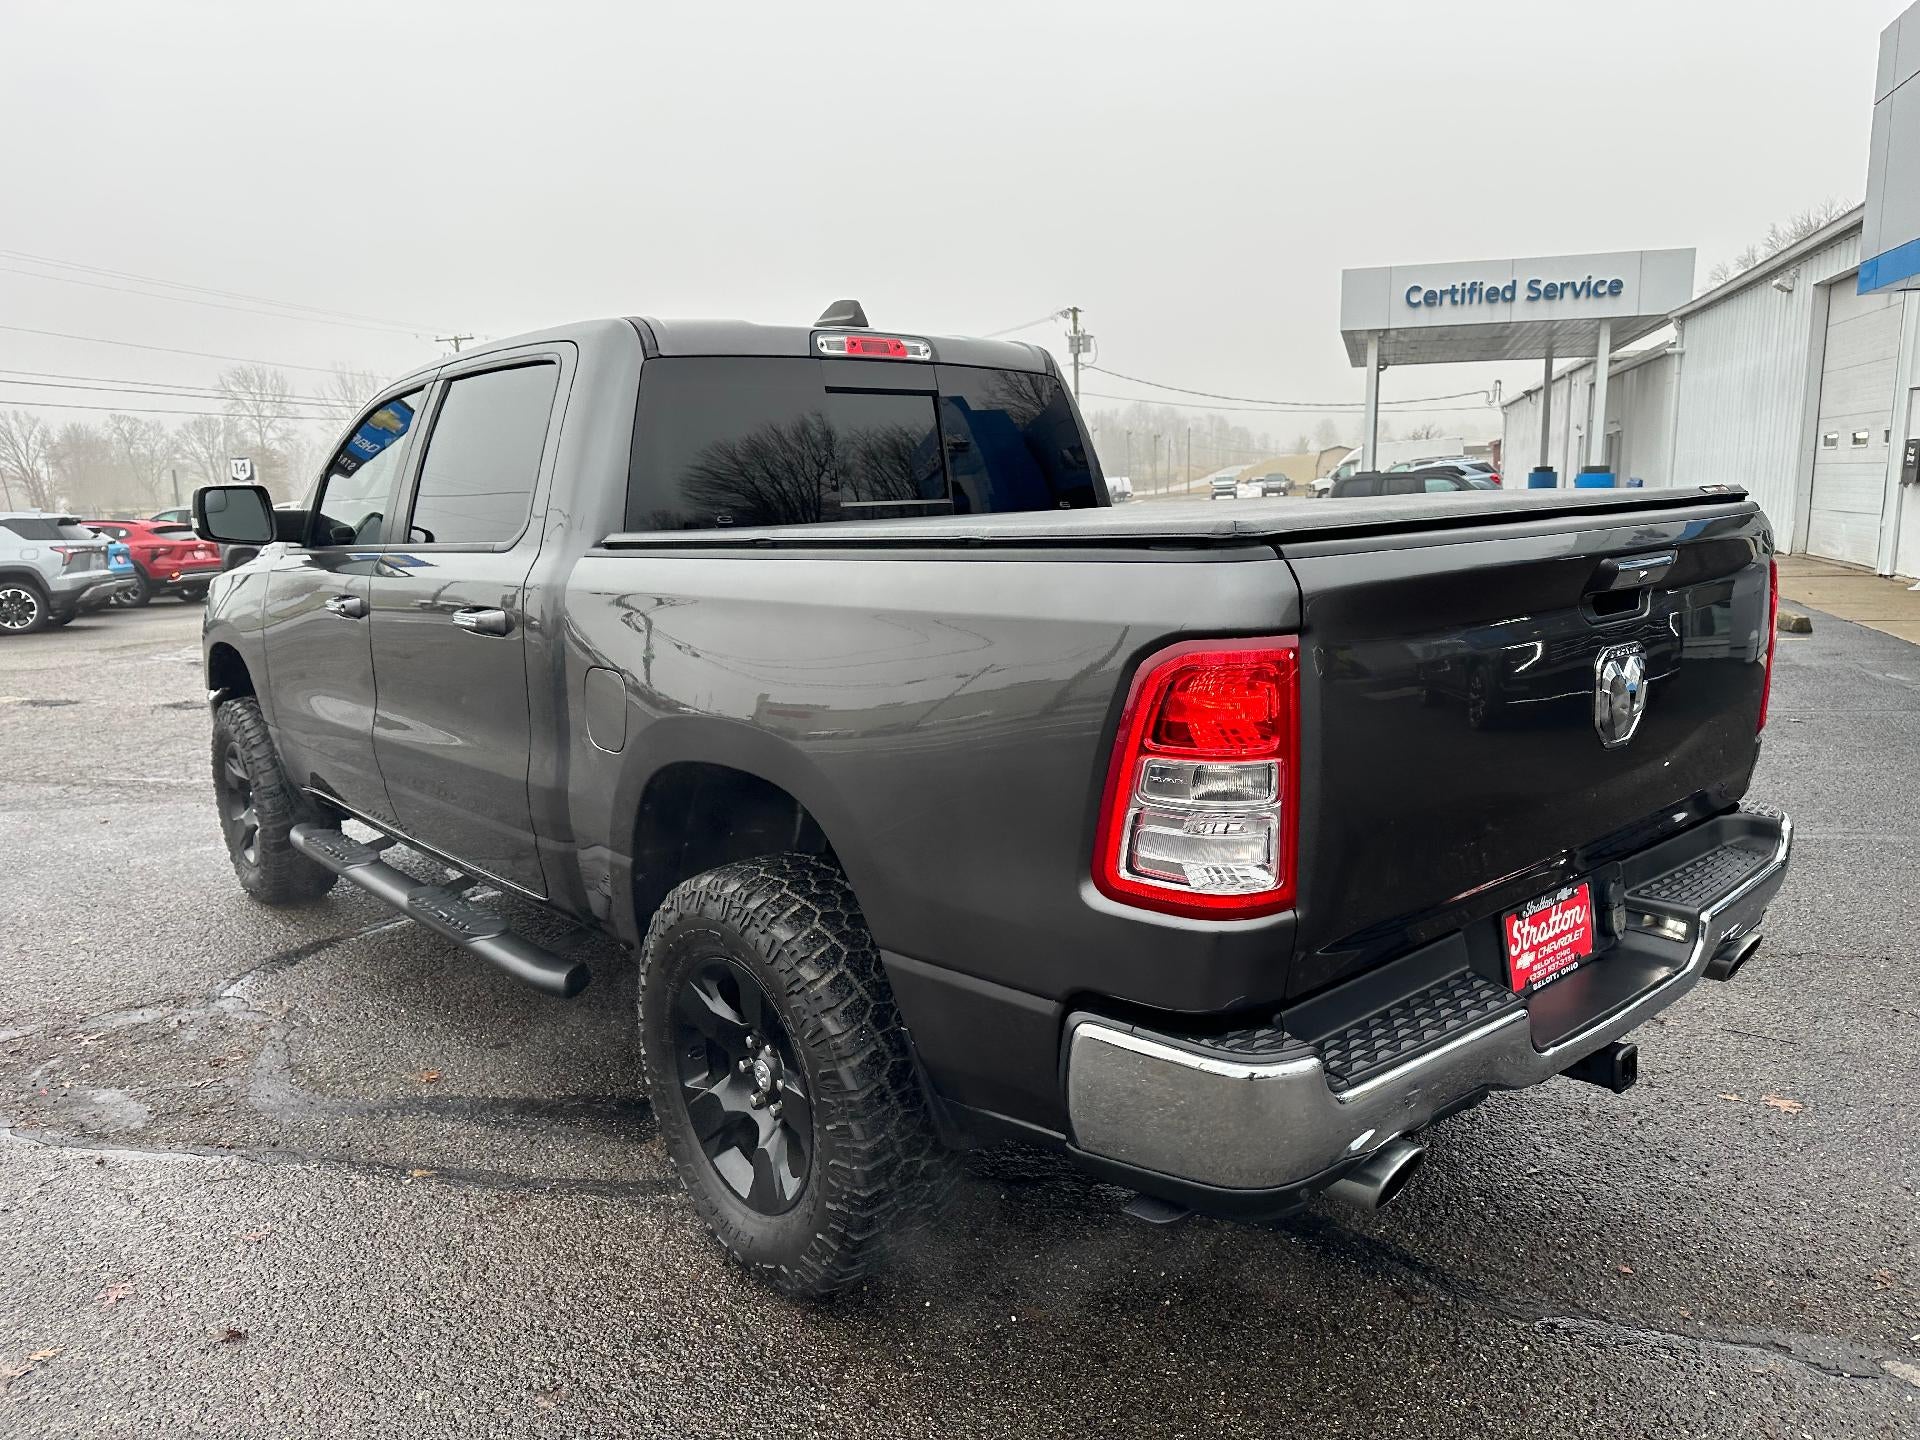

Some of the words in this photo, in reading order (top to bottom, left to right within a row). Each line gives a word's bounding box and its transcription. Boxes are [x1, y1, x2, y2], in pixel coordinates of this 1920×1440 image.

[1405, 279, 1517, 308] Certified
[1526, 275, 1624, 301] Service
[234, 462, 247, 475] 14
[1510, 902, 1587, 956] Stratton
[1537, 927, 1585, 959] CHEVROLET
[1560, 961, 1579, 976] OHIO
